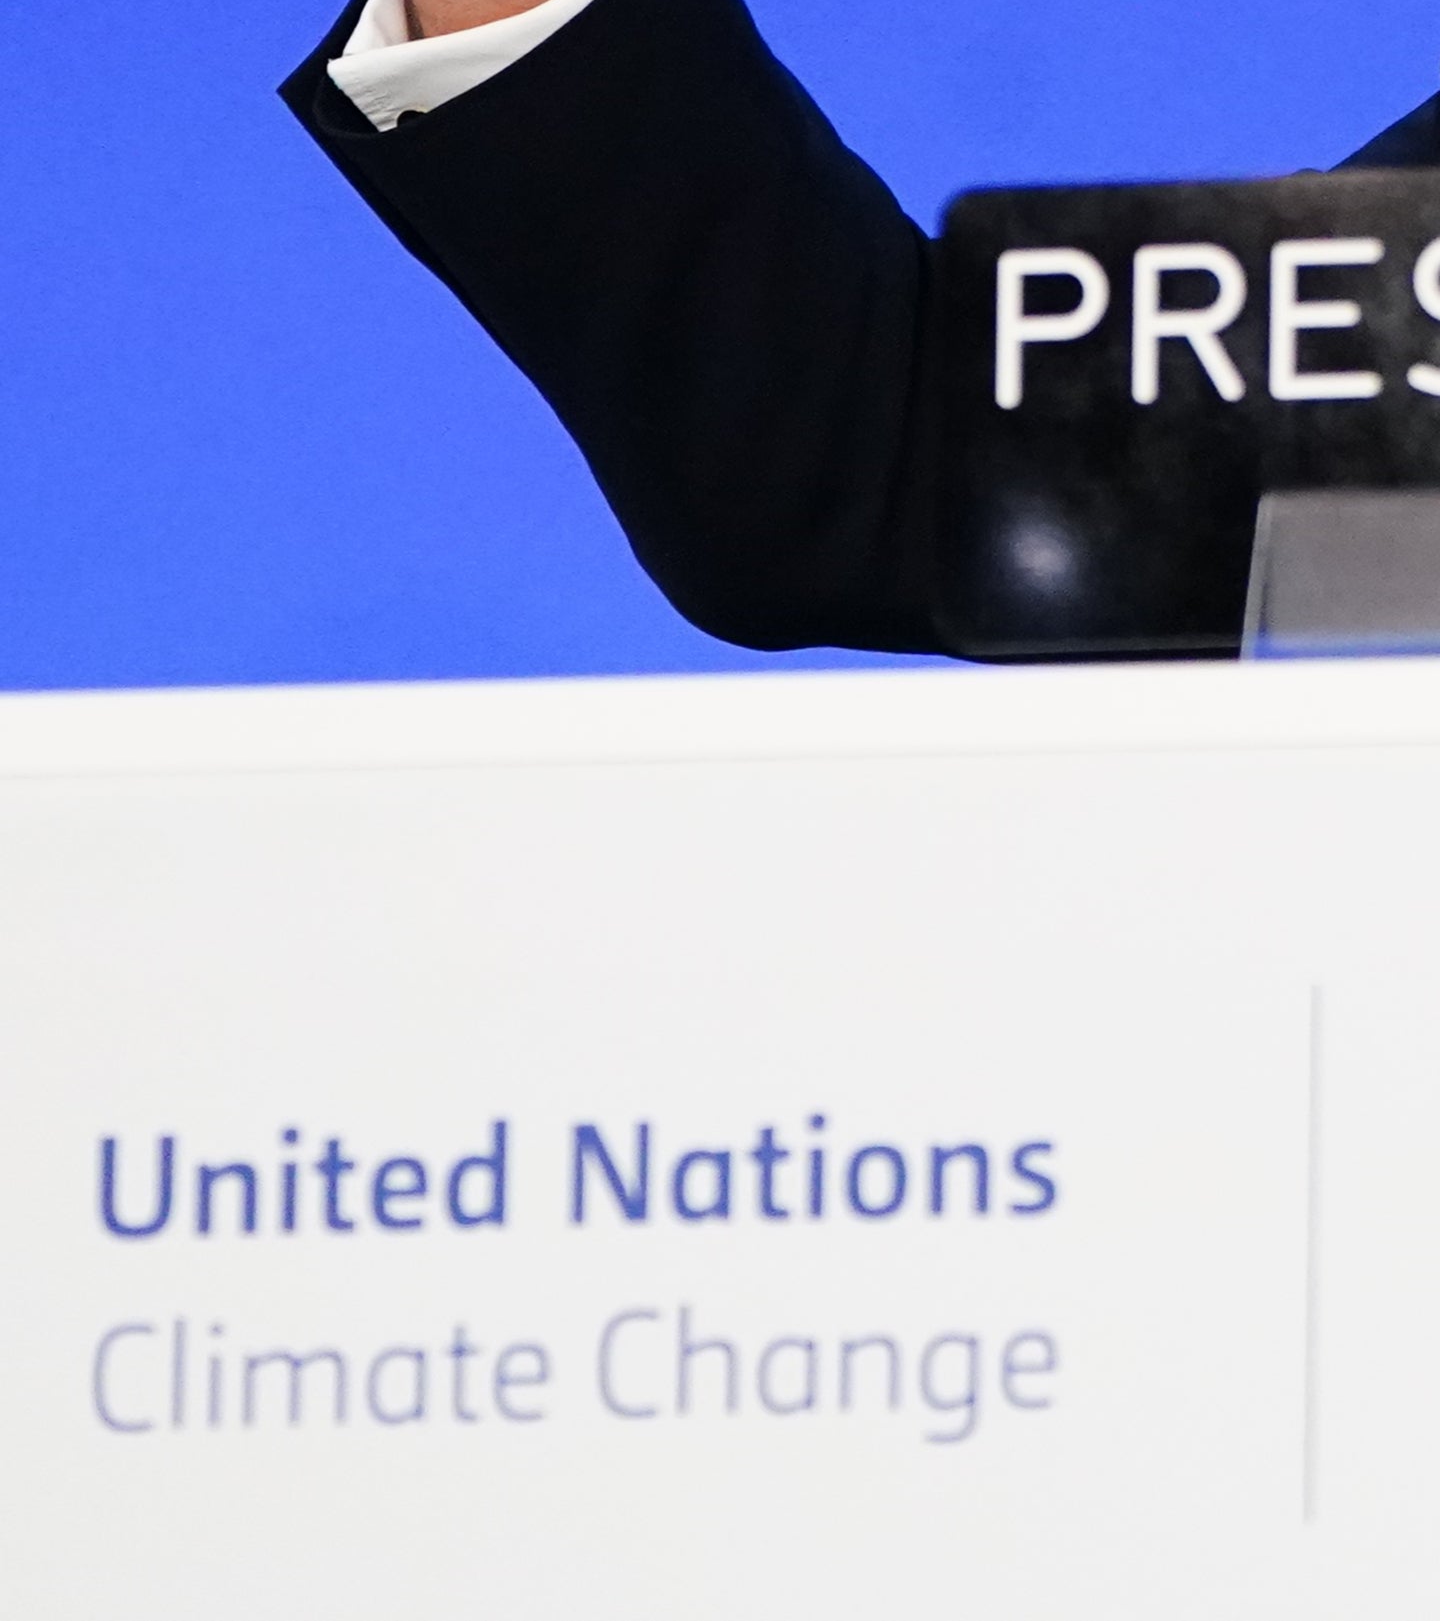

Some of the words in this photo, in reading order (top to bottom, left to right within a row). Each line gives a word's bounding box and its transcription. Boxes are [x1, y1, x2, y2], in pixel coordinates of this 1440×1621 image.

[98, 1118, 509, 1240] United
[568, 1113, 1059, 1226] Nations
[92, 1316, 552, 1435] Climate
[596, 1304, 1060, 1445] Change
